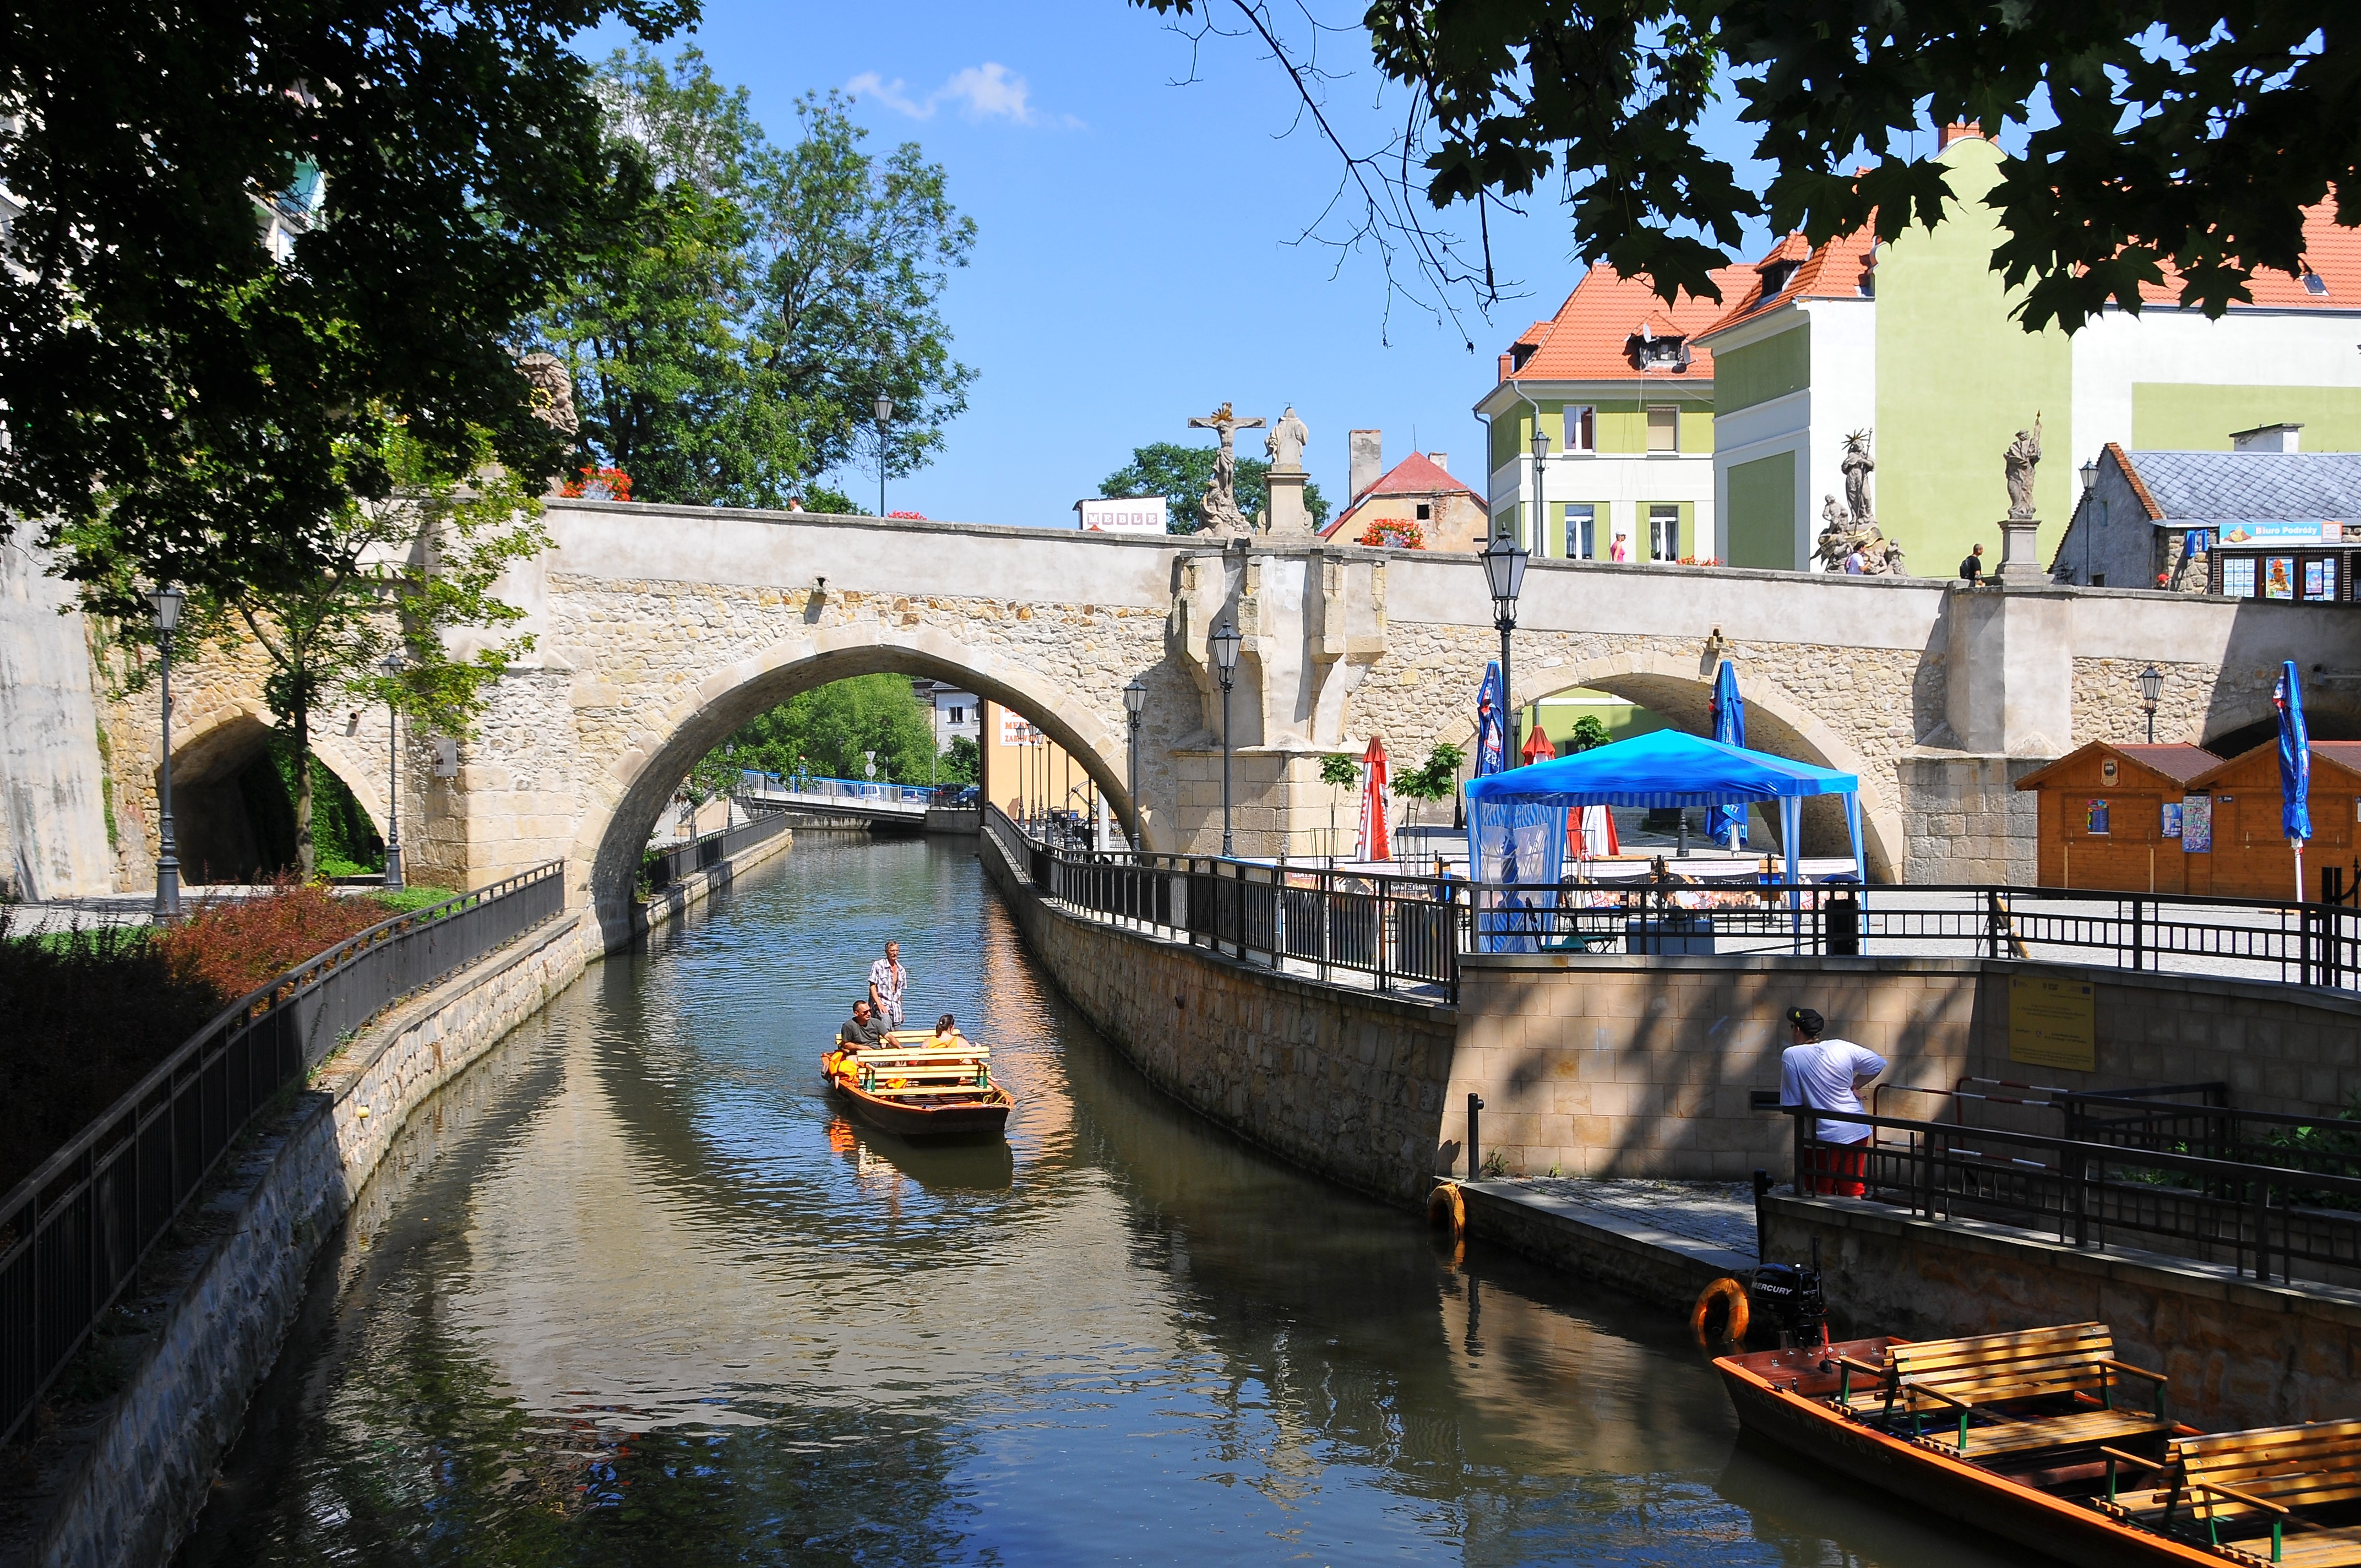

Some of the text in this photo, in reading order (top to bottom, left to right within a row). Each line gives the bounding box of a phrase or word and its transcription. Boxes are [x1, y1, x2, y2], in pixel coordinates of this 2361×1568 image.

[1088, 514, 1156, 523] MEBLE
[2282, 526, 2318, 535] Podróży
[1751, 1281, 1793, 1295] MERCURY
